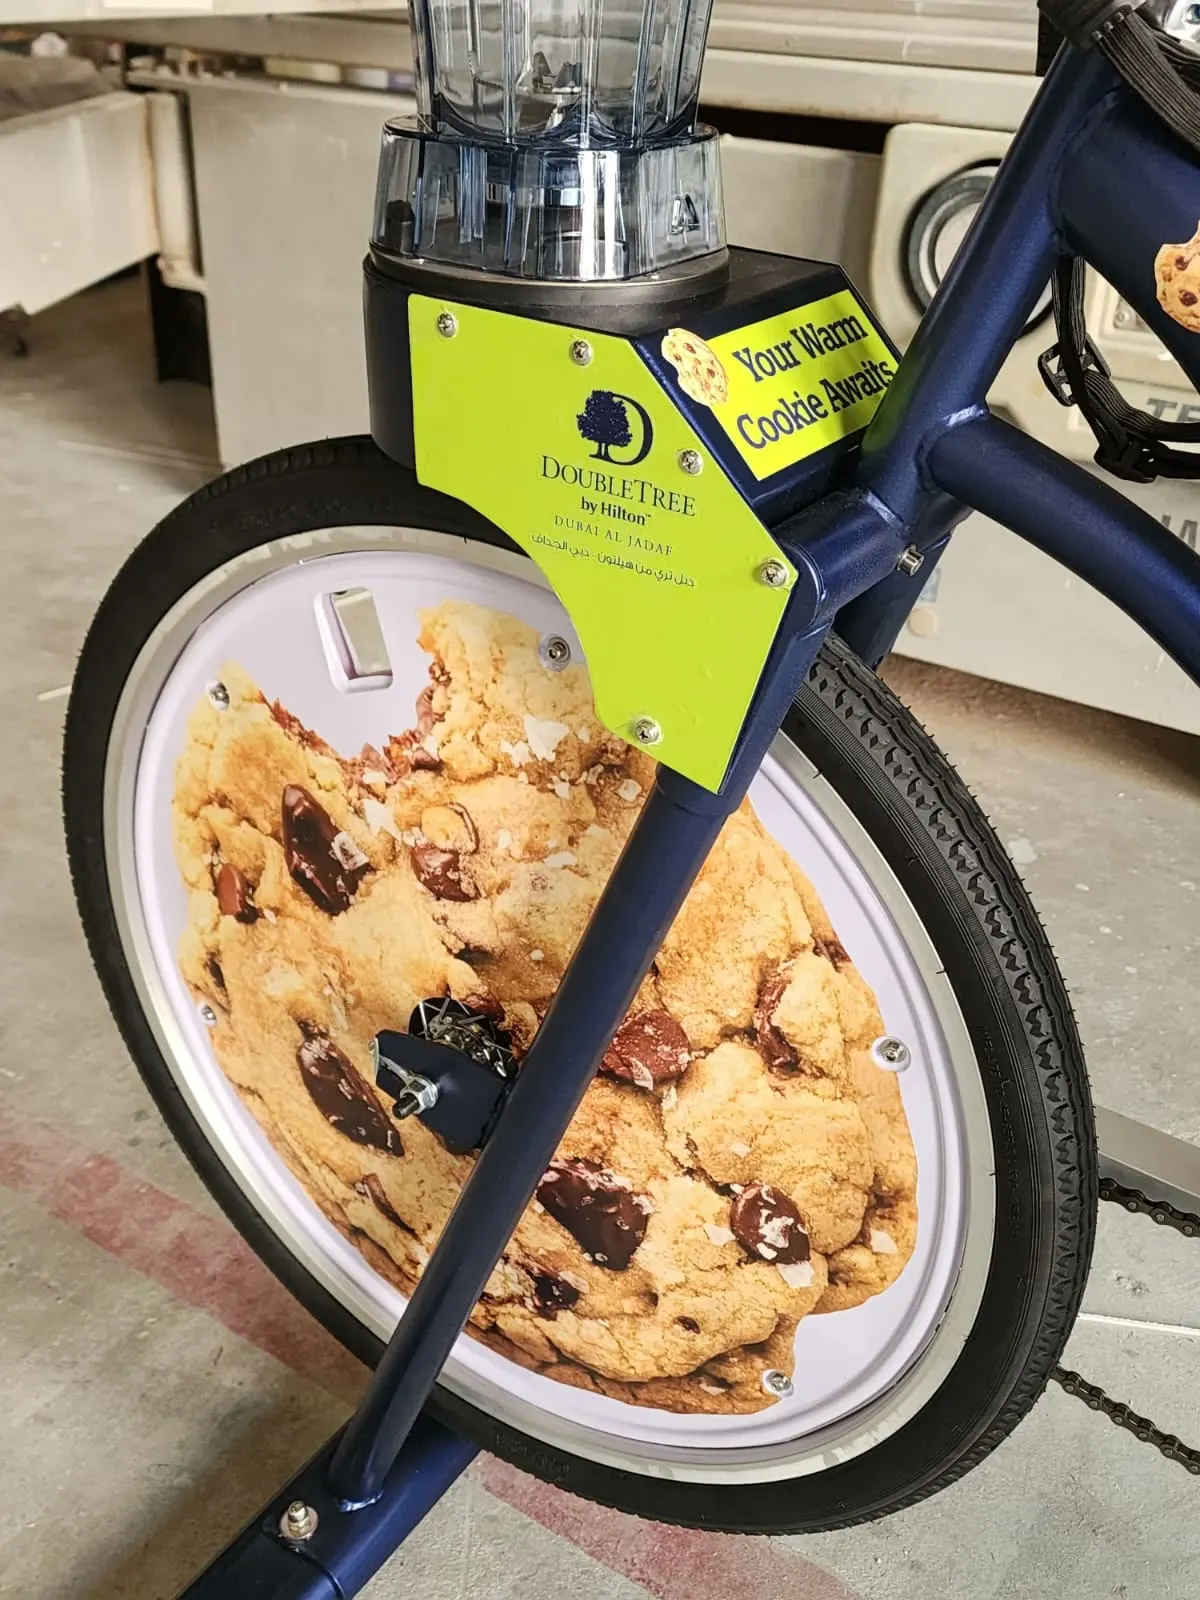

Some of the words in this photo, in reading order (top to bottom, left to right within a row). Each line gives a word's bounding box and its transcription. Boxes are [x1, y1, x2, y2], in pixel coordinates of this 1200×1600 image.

[732, 339, 802, 383] Your
[789, 314, 869, 360] Warm
[736, 391, 829, 450] Cookie
[819, 360, 895, 413] Awaits
[581, 496, 599, 516] by
[554, 514, 599, 537] DUBAI
[604, 530, 622, 543] AL
[627, 536, 673, 557] JADAF
